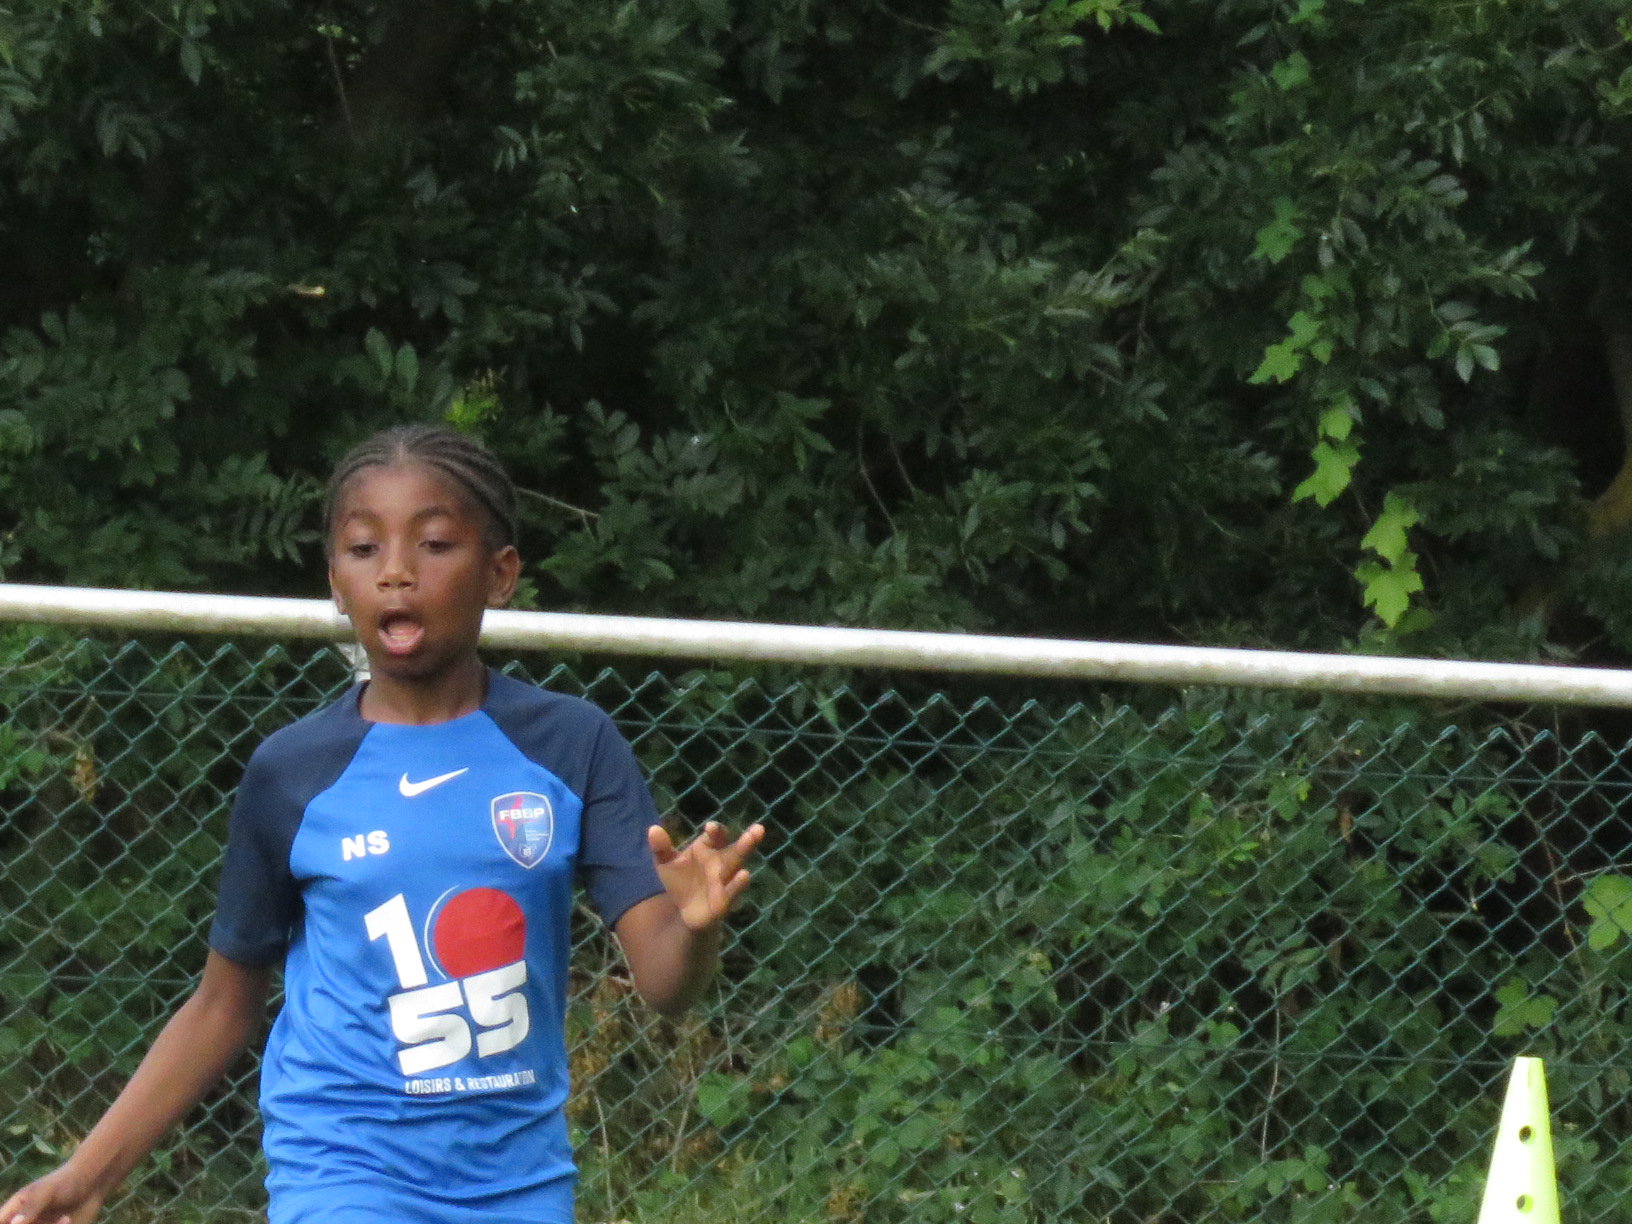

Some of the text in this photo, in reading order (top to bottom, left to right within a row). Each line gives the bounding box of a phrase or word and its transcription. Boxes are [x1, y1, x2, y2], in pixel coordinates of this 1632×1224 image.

[342, 830, 390, 861] NS
[387, 960, 530, 1077] 55
[405, 1077, 452, 1095] LOISIRS
[455, 1076, 467, 1092] &
